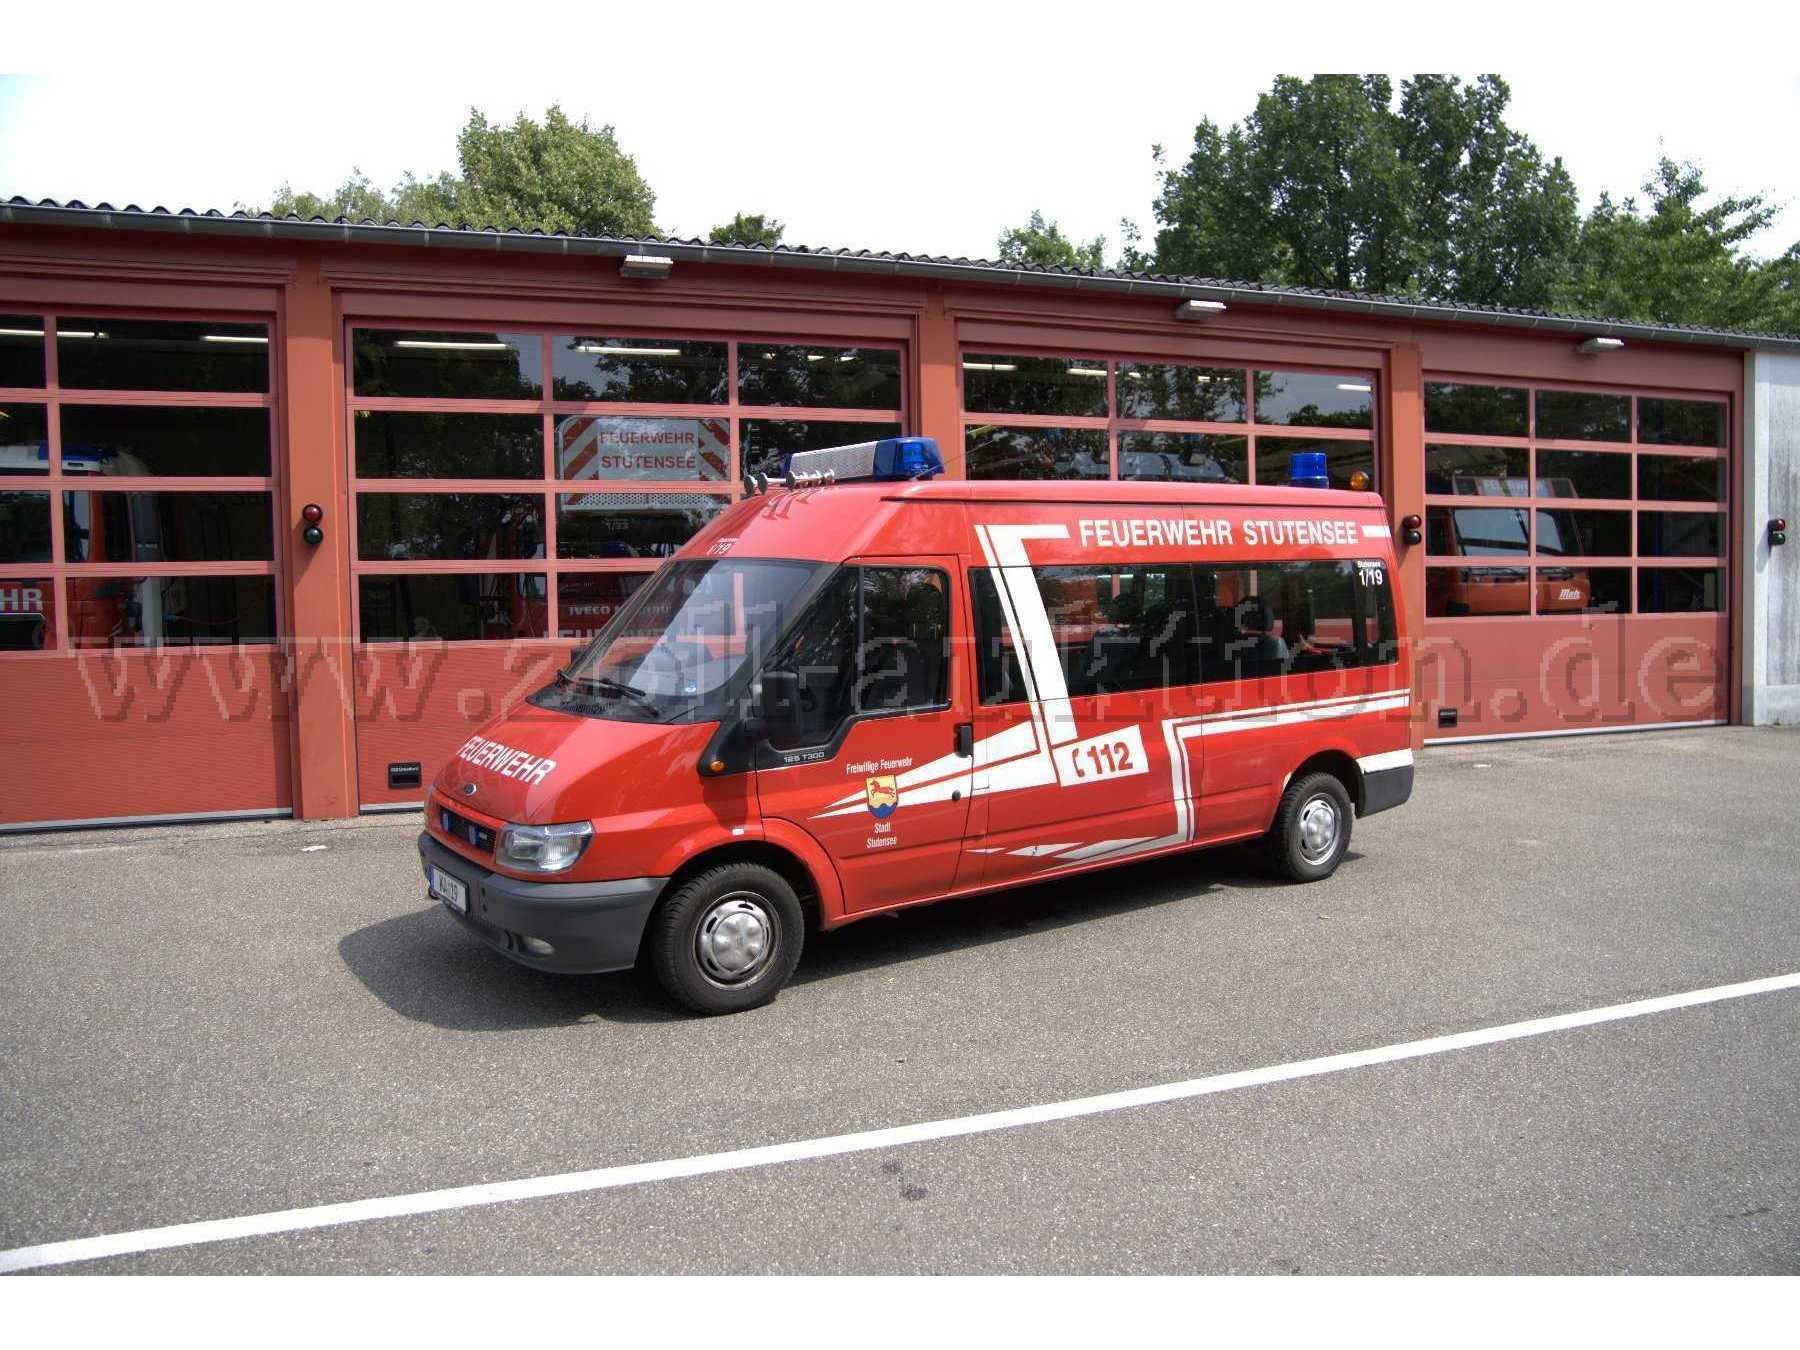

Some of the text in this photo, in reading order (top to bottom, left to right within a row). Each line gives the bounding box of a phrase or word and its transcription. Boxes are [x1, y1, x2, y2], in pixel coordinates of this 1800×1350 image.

[600, 431, 695, 444] FEUERWEHR
[601, 456, 697, 469] STUTENSEE
[1078, 518, 1359, 548] FEUERWEHR STUTENSEE
[1358, 568, 1383, 587] 1/19
[568, 605, 611, 616] IVECO
[456, 735, 558, 785] FEUERWEHR
[846, 756, 913, 775] Freiwillige Feuerwehr
[1087, 741, 1133, 775] 112
[874, 821, 891, 834] Stadt
[866, 835, 898, 849] Stutensee
